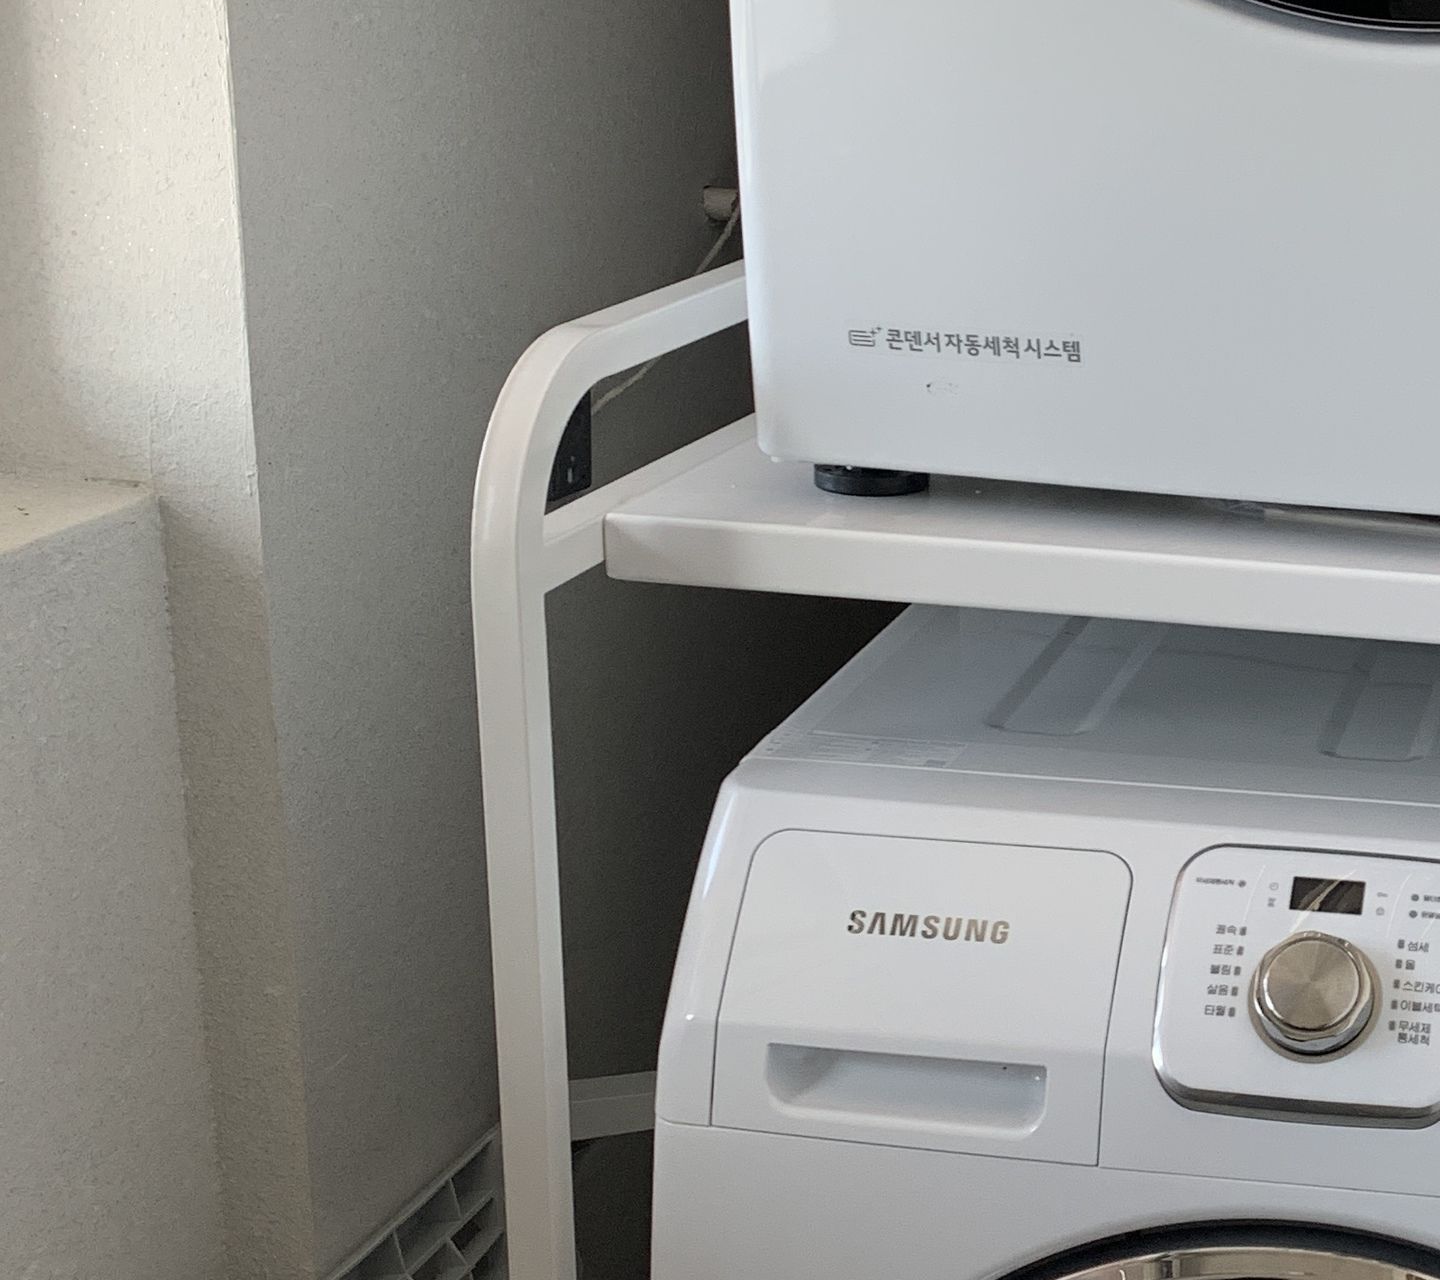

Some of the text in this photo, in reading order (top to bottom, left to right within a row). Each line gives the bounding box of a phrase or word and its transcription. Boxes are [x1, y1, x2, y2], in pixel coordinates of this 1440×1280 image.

[885, 328, 1081, 363] 콘덴서 자동세척 시스템
[847, 909, 1010, 944] SAMSUNG
[1213, 944, 1234, 955] 표준
[1407, 941, 1429, 953] 섬세
[1398, 1020, 1431, 1034] 무세제
